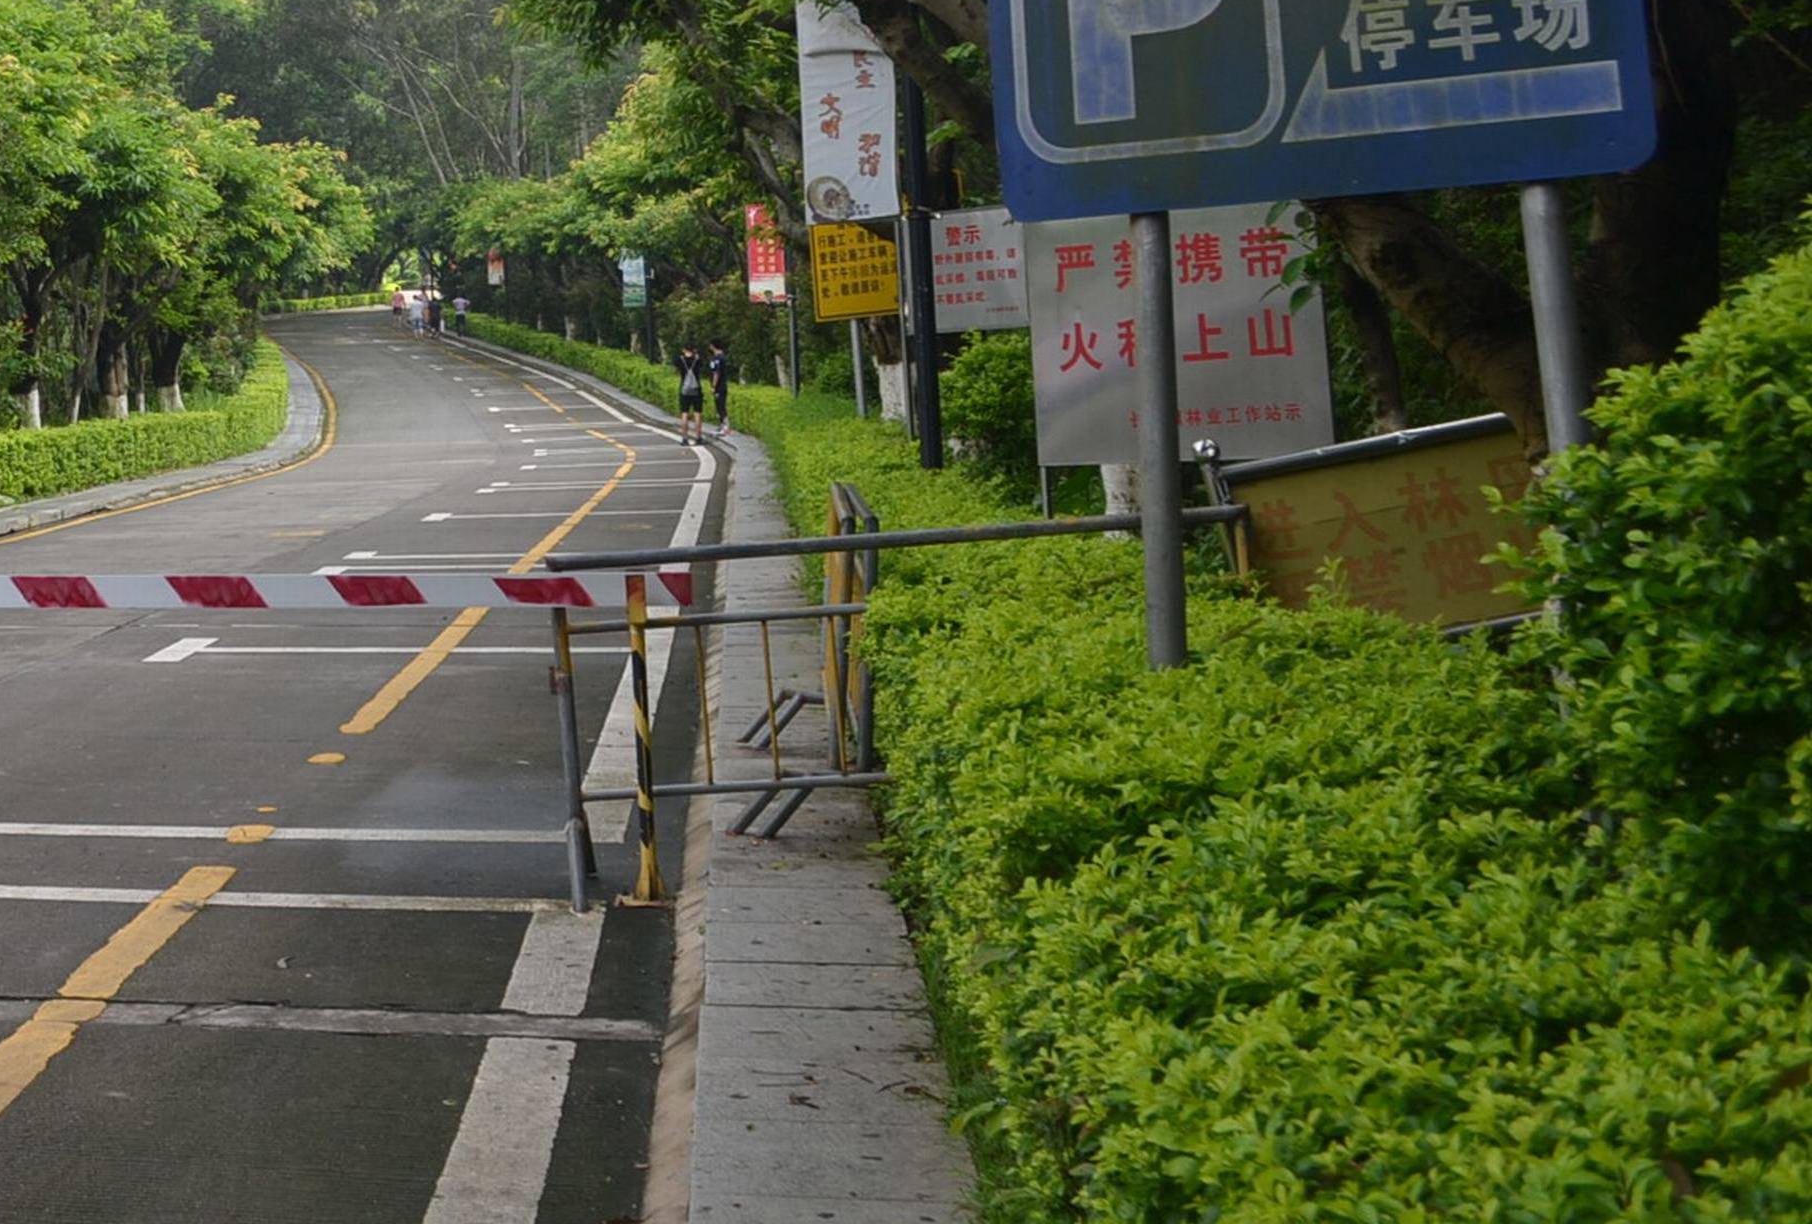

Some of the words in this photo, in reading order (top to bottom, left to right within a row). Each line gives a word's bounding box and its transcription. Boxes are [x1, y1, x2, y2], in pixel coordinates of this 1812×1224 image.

[818, 93, 842, 140] 文明
[857, 132, 881, 178] 和谐
[946, 224, 981, 247] 警示
